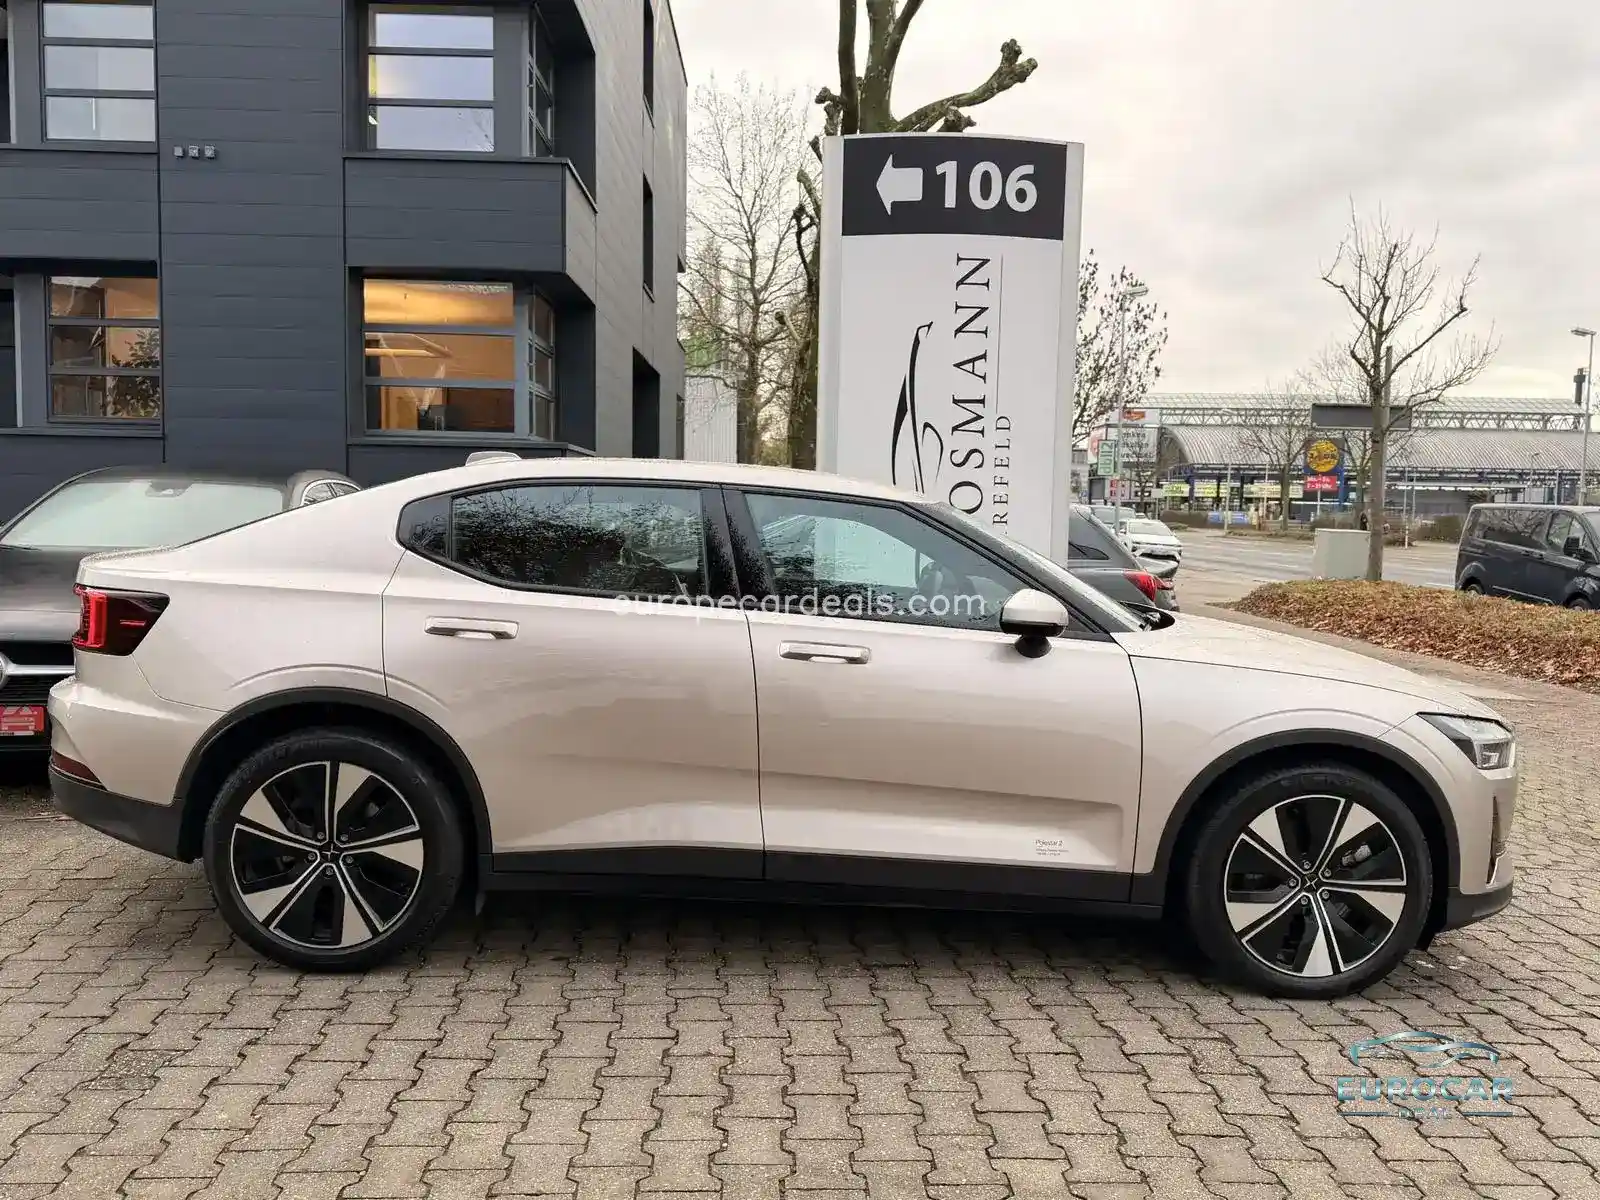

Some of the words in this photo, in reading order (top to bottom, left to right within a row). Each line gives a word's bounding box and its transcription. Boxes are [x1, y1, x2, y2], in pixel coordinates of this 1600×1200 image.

[935, 160, 1038, 213] 106
[948, 253, 991, 515] OSMANN
[992, 415, 1012, 534] REFELD
